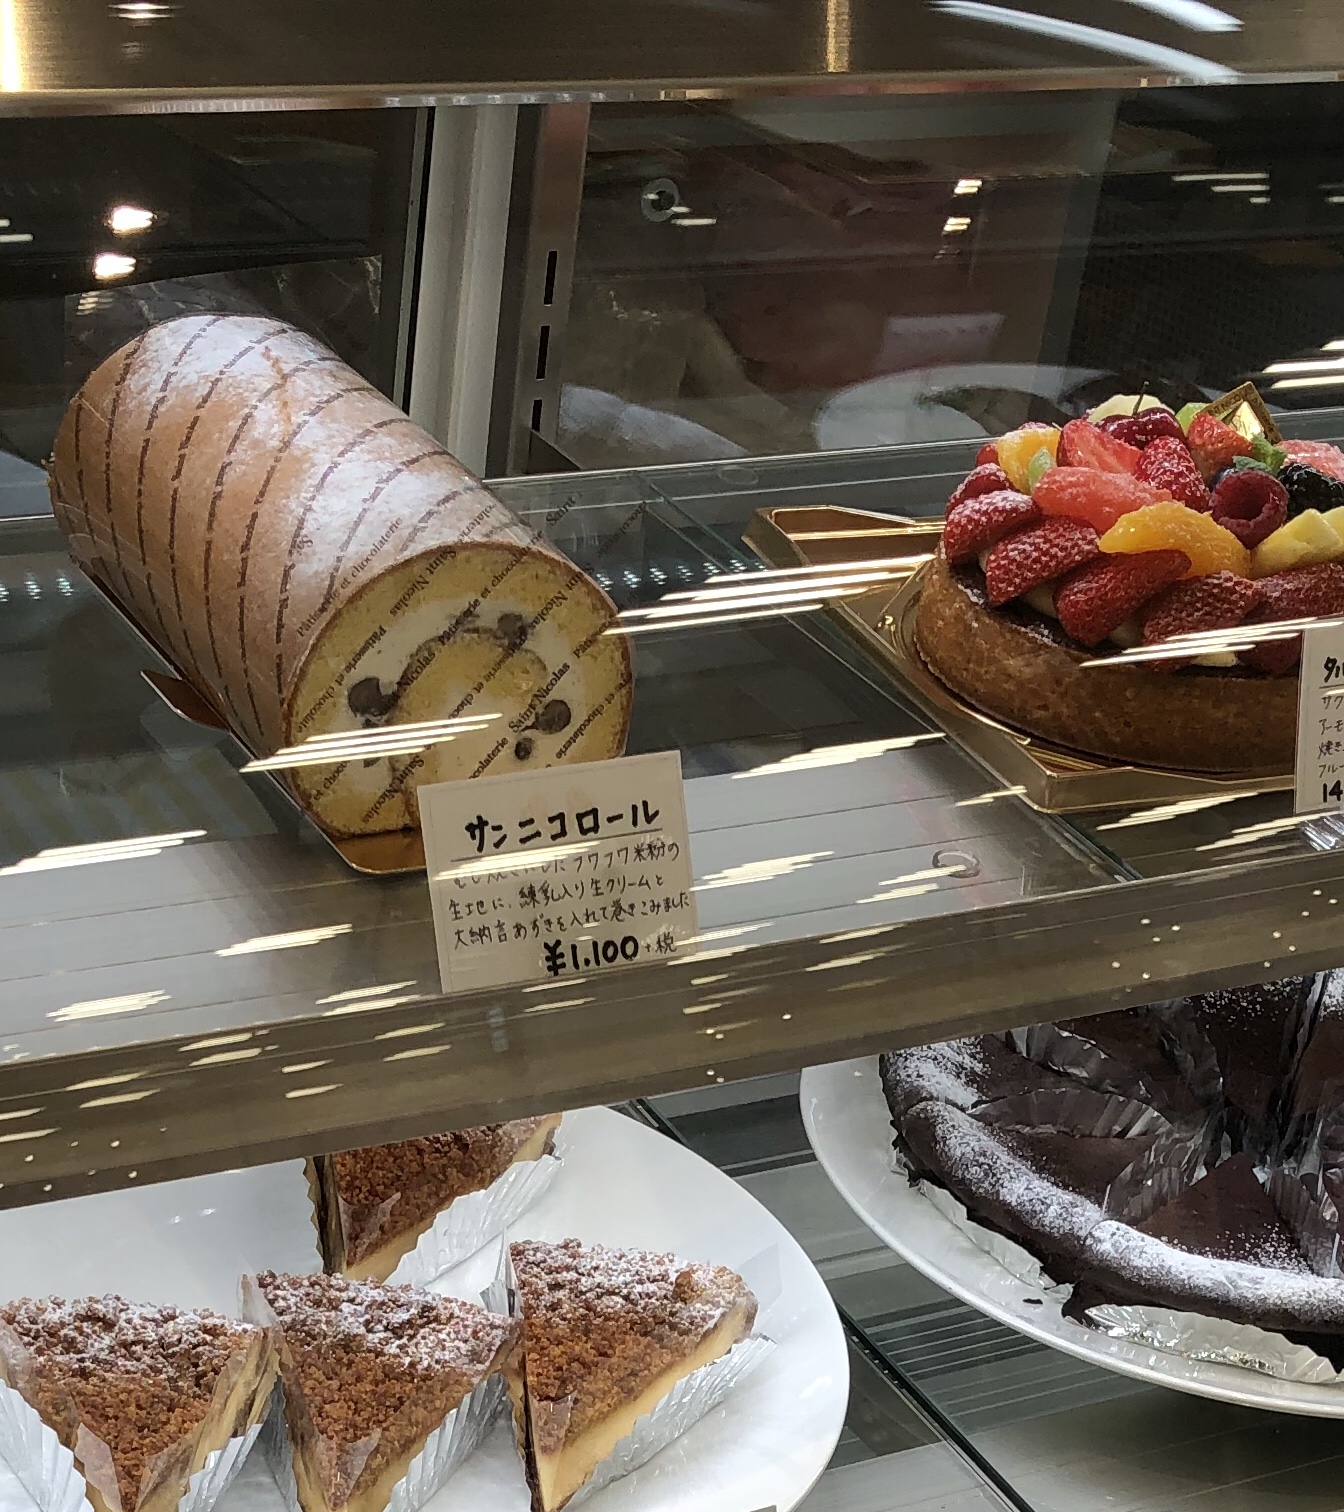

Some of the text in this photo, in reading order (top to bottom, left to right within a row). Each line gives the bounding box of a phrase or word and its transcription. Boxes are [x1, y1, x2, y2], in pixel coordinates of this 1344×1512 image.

[349, 518, 403, 576] chocolaterie
[389, 575, 429, 617] Nicolas
[533, 662, 571, 702] Nicolas
[463, 789, 661, 854] サンニコロール
